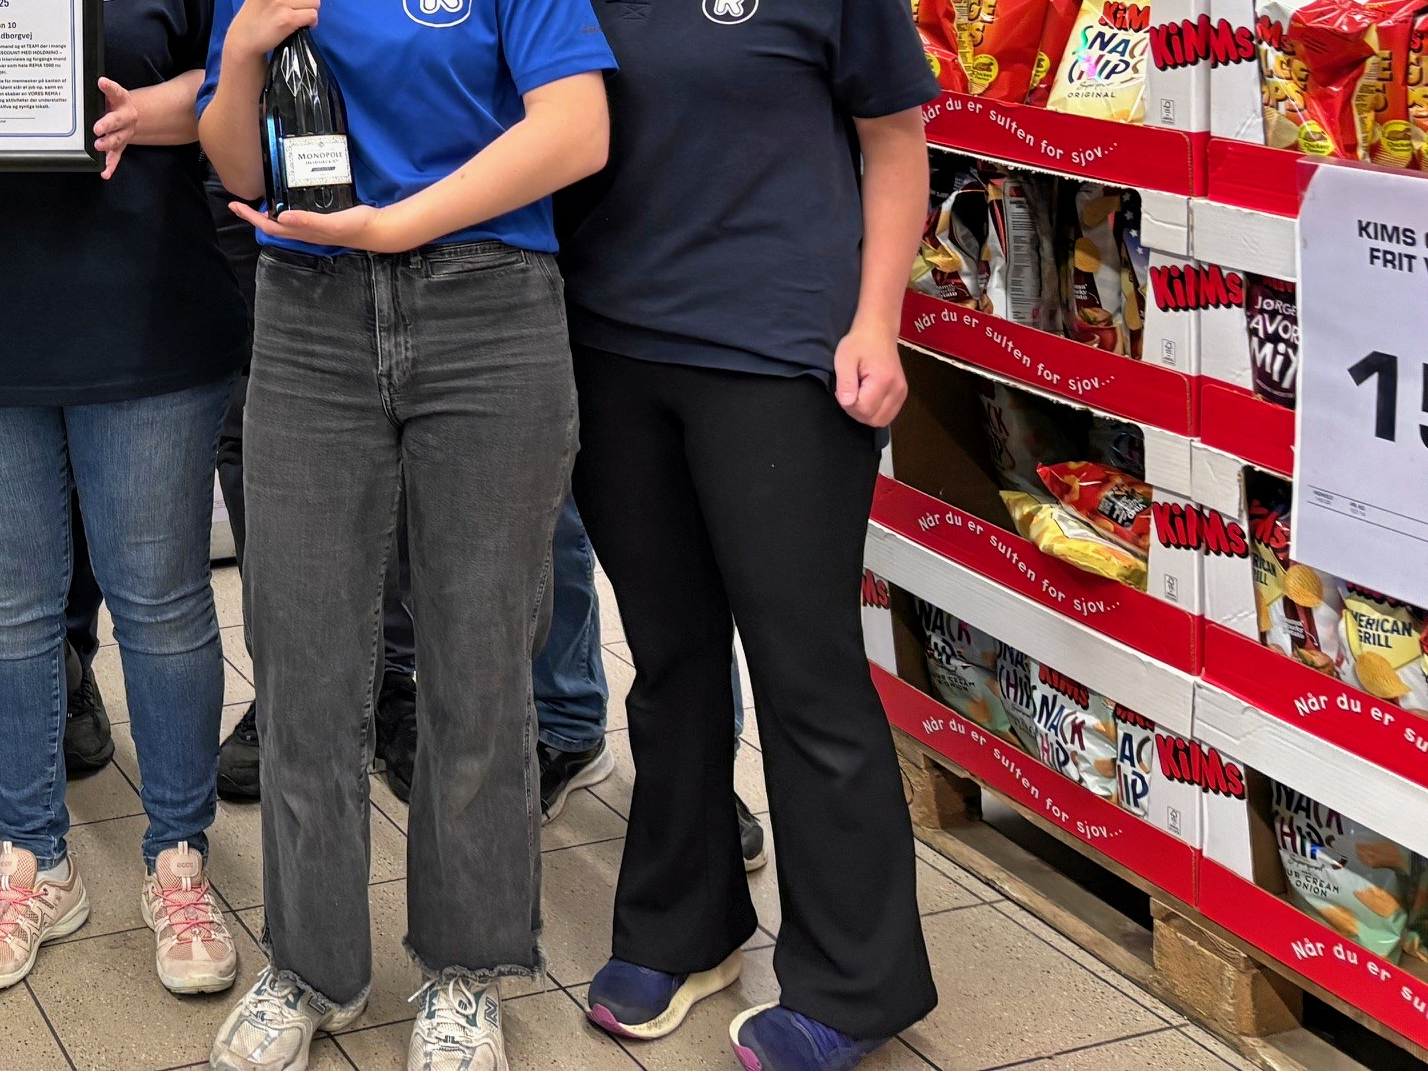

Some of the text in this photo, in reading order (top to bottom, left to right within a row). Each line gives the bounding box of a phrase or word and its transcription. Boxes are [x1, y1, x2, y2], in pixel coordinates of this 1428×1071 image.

[1067, 91, 1116, 99] ORIGINAL
[946, 98, 962, 111] du
[968, 101, 982, 113] er
[989, 109, 1035, 147] sulten
[1040, 140, 1064, 160] for
[298, 151, 343, 159] MONOPOLE
[1357, 219, 1417, 247] KIMS
[1368, 247, 1417, 273] FRIT
[914, 312, 936, 333] Når
[941, 309, 958, 323] du
[963, 315, 980, 329] er
[985, 326, 1031, 367] sulten
[1036, 363, 1061, 385] for
[918, 512, 940, 532] Når
[945, 511, 962, 527] du
[967, 520, 984, 535] er
[989, 534, 1036, 582] sulten
[1041, 578, 1066, 603] for
[1294, 691, 1396, 725] Når du er
[922, 716, 944, 735] Når
[948, 719, 966, 735] du
[970, 729, 987, 746] er
[993, 747, 1040, 799] sulten
[1045, 798, 1070, 823] for
[1295, 880, 1328, 898] ONION
[1305, 875, 1340, 894] CREAM
[1290, 937, 1392, 982] Når du er
